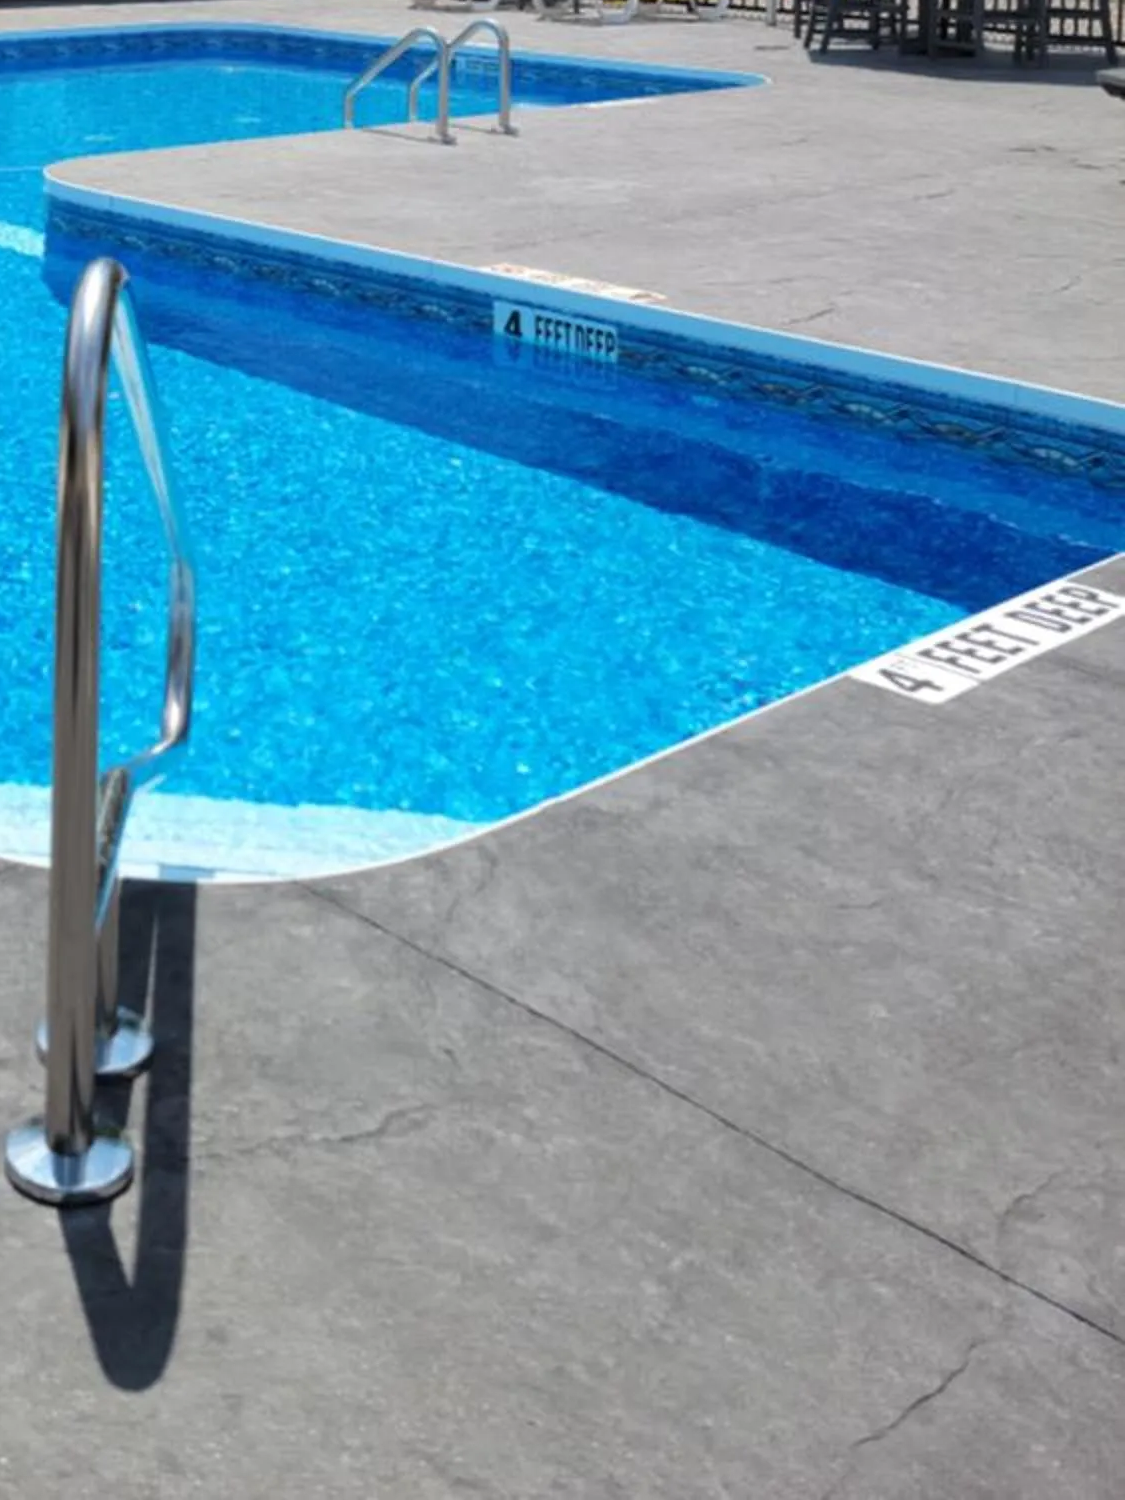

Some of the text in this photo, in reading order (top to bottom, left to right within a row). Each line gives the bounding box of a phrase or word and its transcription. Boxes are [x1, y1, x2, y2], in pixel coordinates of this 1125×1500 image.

[504, 309, 616, 356] 4 FEET DEEP
[877, 585, 1121, 693] 4 FEET DEEP
